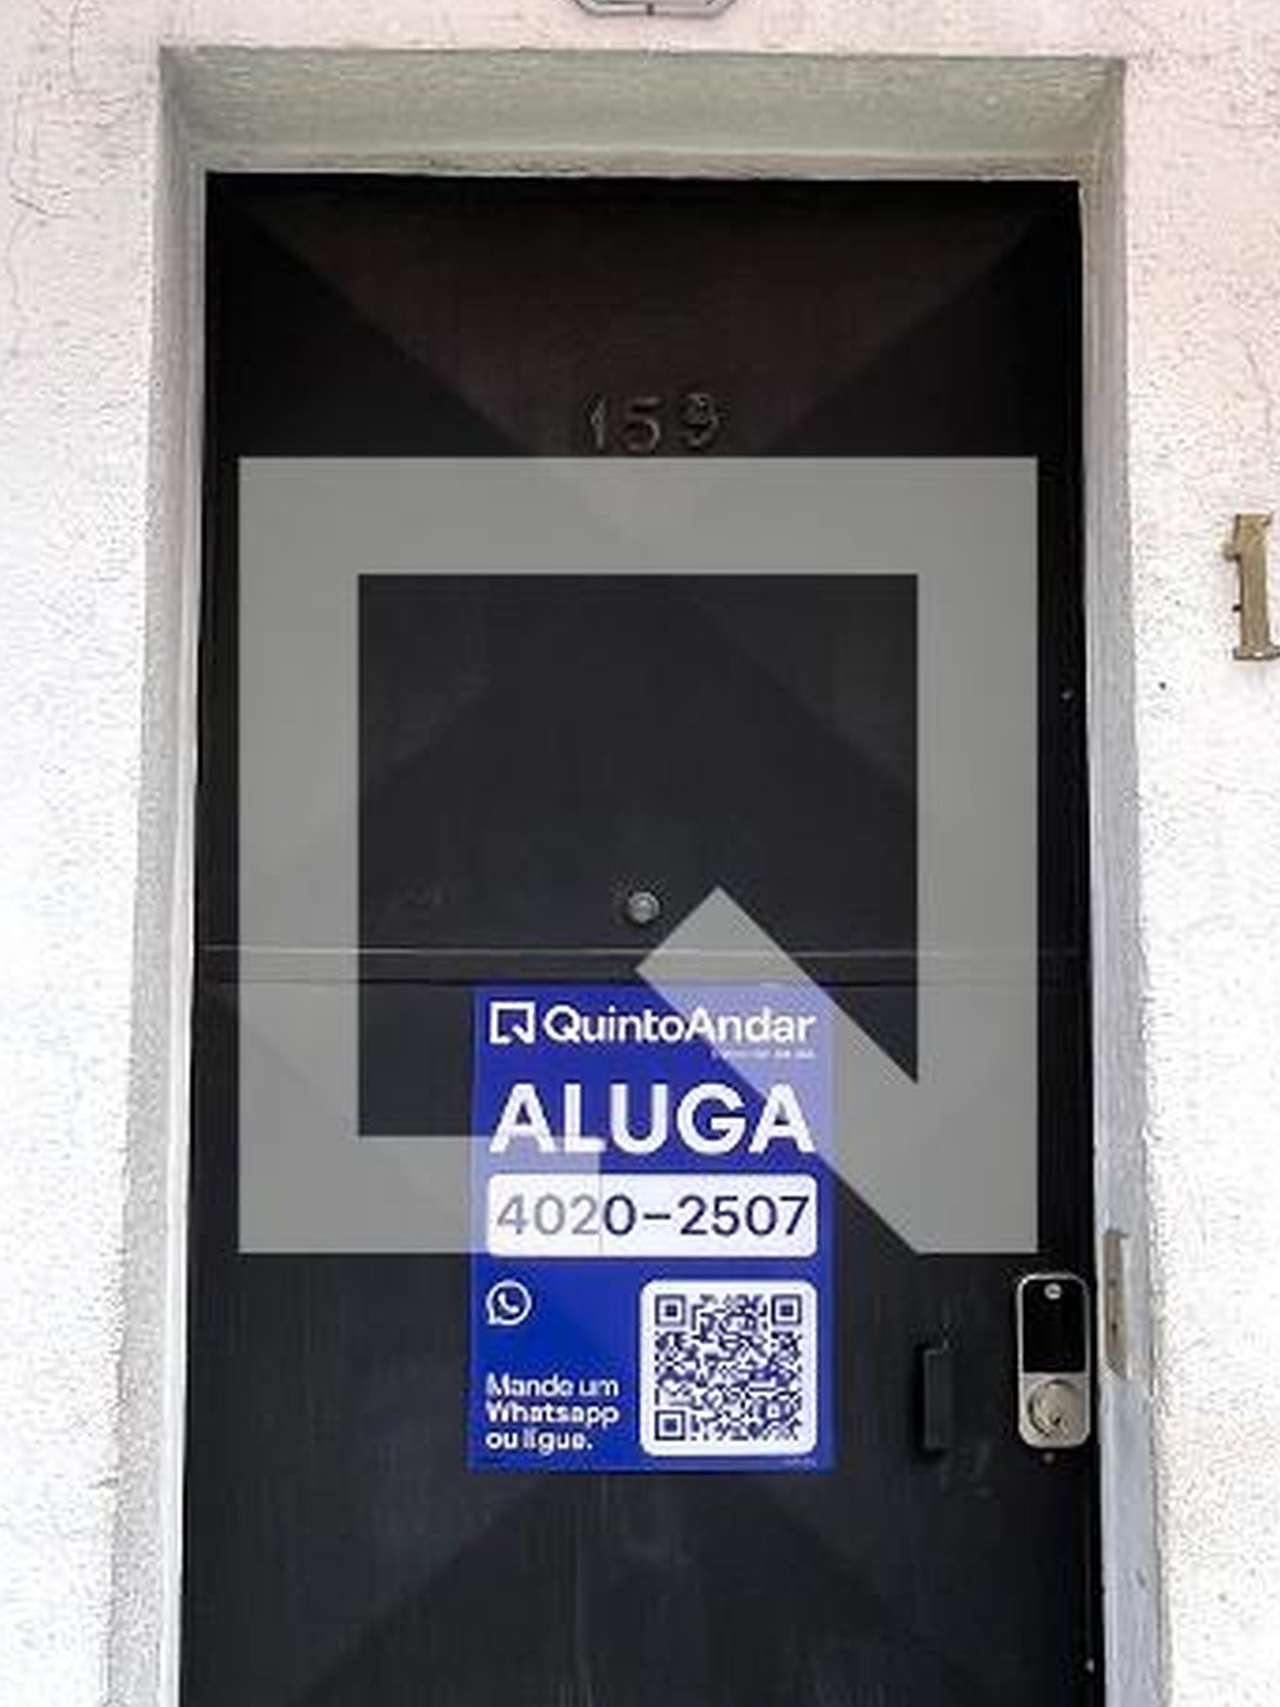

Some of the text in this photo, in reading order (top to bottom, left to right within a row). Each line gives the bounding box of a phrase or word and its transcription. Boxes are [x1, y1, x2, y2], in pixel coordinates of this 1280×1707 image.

[584, 392, 723, 454] 159
[543, 1003, 817, 1044] QuintoAndar
[489, 1082, 816, 1155] ALUGA
[496, 1192, 811, 1237] 4020-2507
[577, 1379, 618, 1397] um
[485, 1401, 619, 1427] Whatsapp
[485, 1426, 593, 1455] ou ligue.
